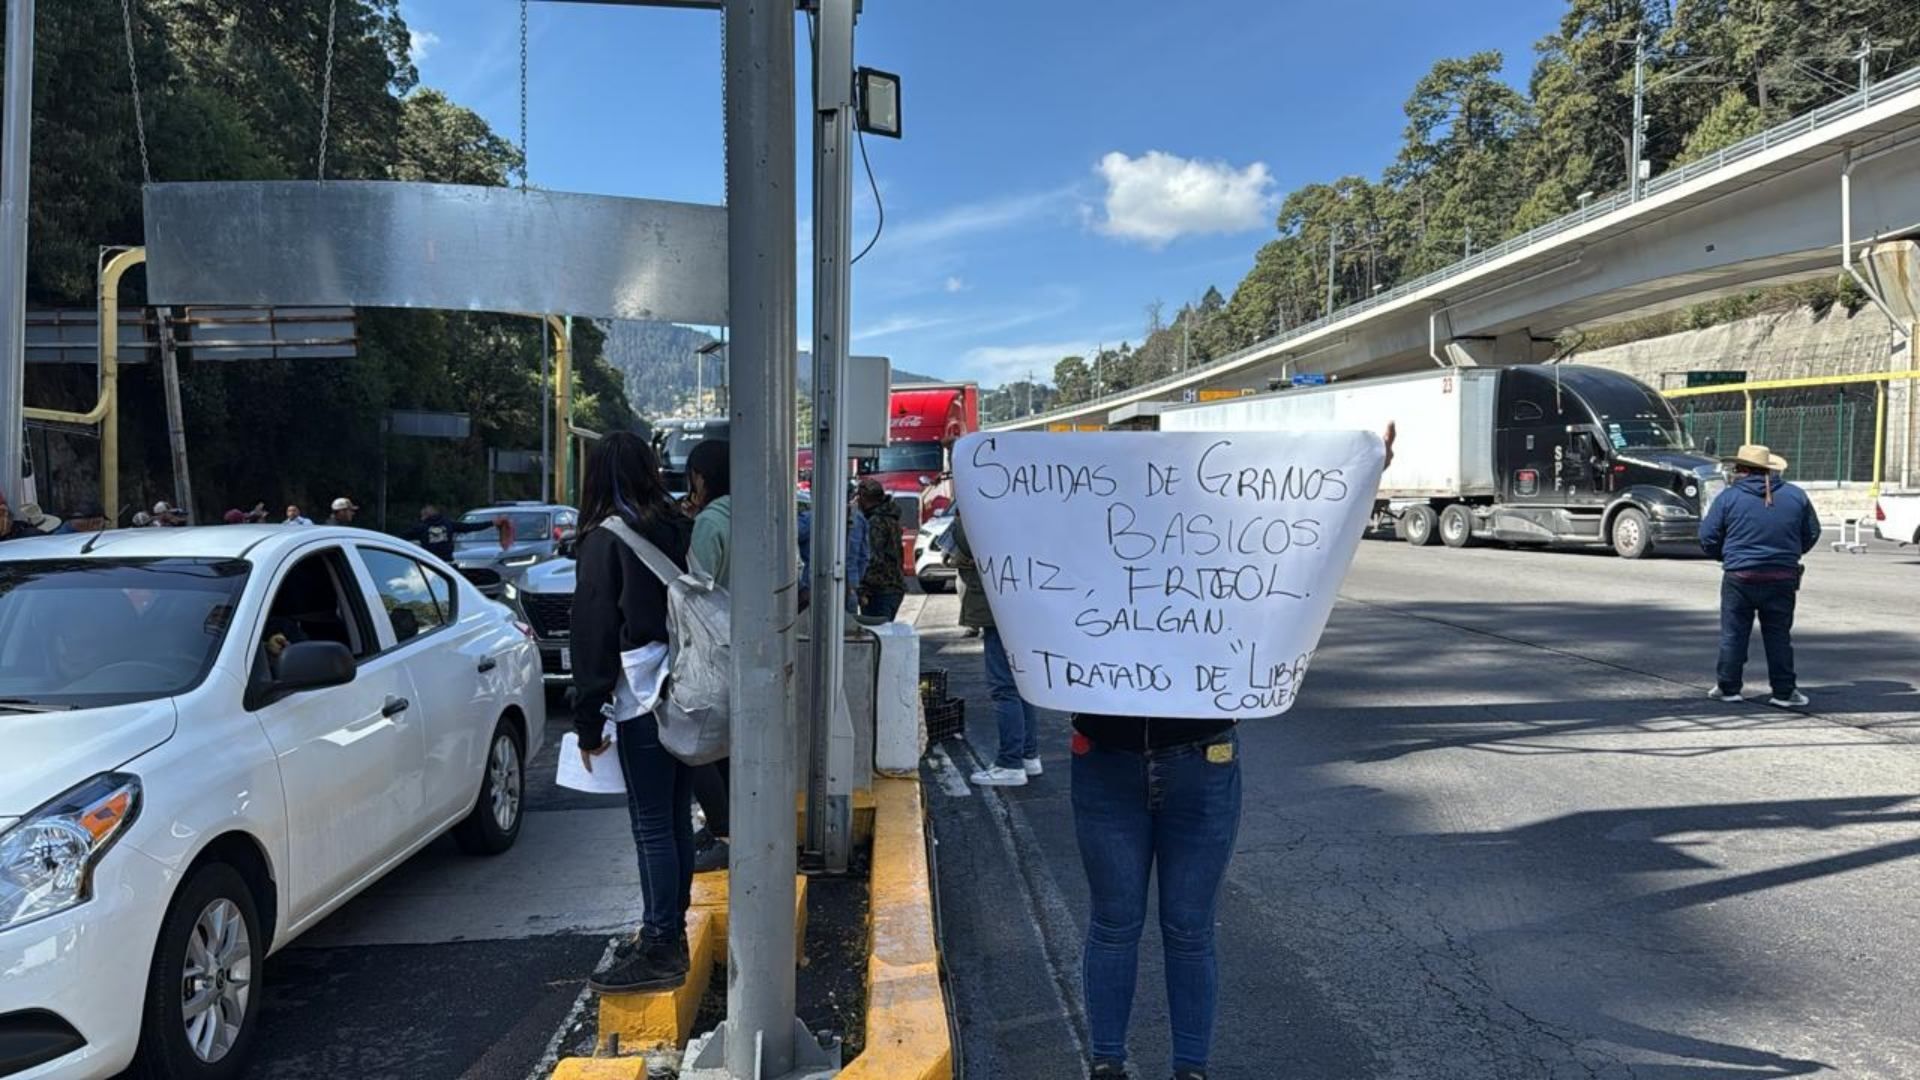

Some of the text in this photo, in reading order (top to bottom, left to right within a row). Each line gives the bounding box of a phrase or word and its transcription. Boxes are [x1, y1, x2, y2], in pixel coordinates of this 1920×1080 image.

[973, 438, 1348, 502] SALIDAS DE GRANOS
[1031, 650, 1172, 691] TRATADO
[1195, 664, 1232, 692] DE
